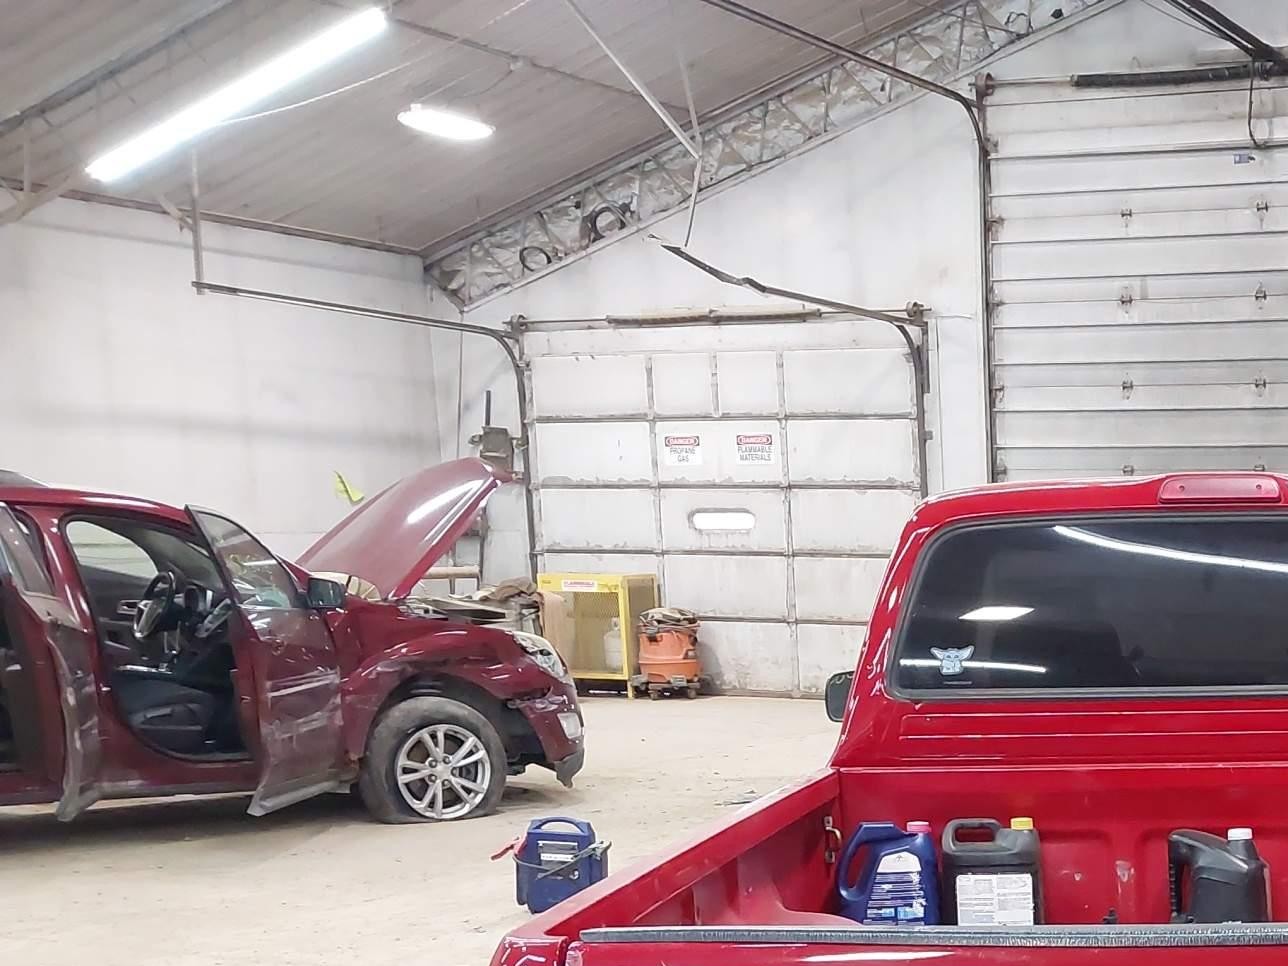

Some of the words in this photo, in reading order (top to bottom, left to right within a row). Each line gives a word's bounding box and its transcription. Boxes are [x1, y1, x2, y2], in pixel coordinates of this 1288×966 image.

[741, 435, 767, 444] DANGER
[670, 447, 696, 455] PROPANE
[737, 445, 772, 454] FLAMMABLE
[677, 454, 689, 462] GAS
